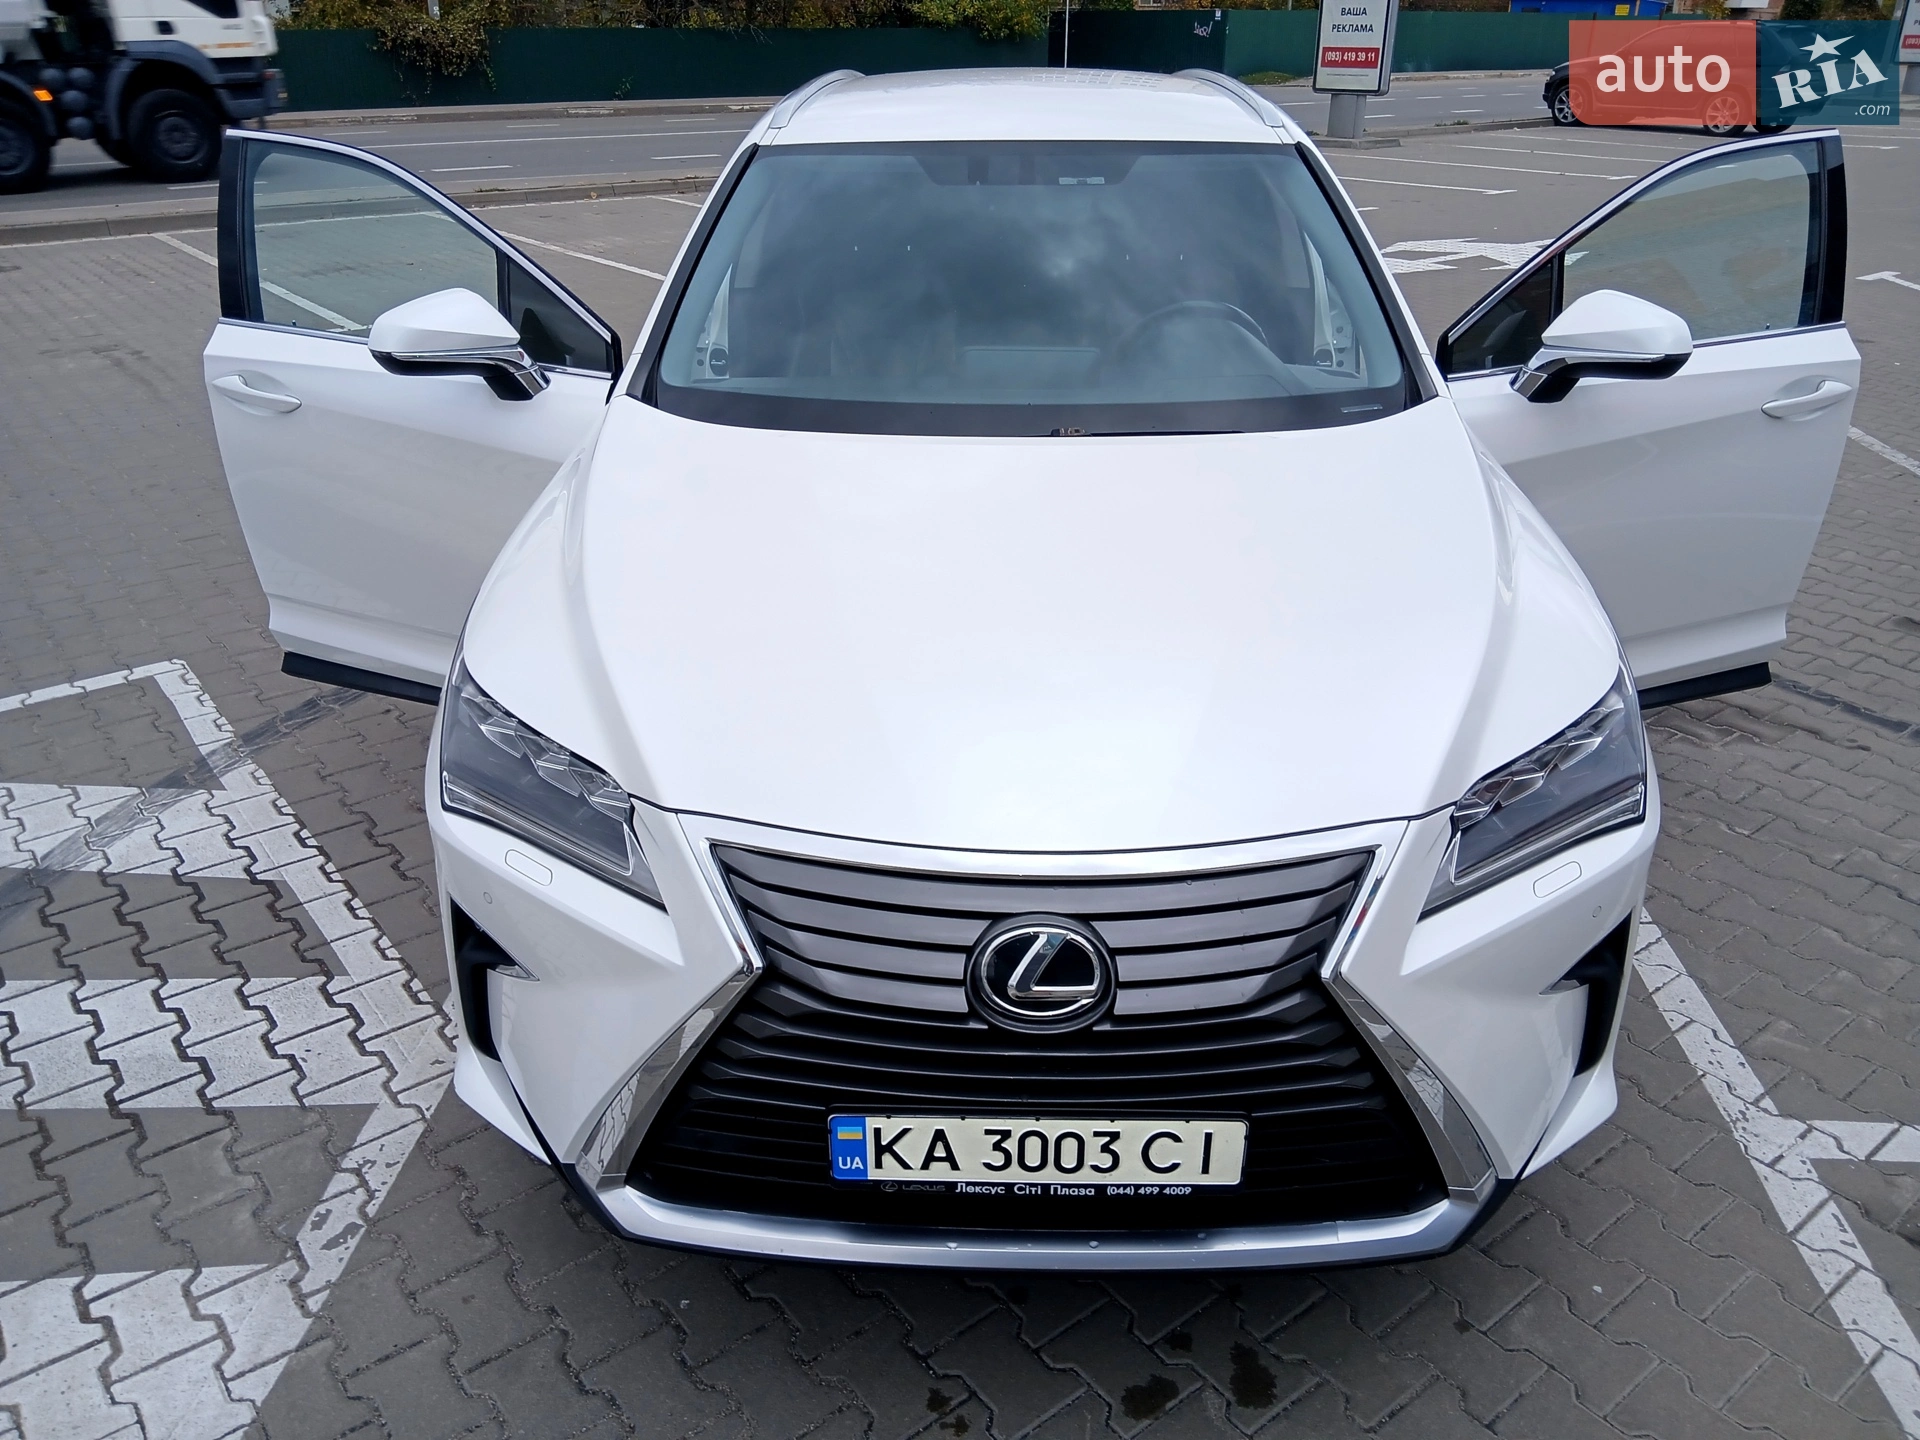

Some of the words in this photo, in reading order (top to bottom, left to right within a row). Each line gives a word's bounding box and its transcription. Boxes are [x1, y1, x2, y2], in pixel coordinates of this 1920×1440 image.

[1341, 7, 1367, 16] ВАША
[1332, 24, 1374, 33] РЕКЛАМА
[1325, 51, 1342, 63] (093)
[1343, 52, 1356, 61] 419
[1357, 52, 1366, 61] 39
[1367, 52, 1375, 61] 11
[838, 1156, 864, 1170] UA
[872, 1127, 961, 1171] KA
[981, 1129, 1121, 1174] 3003
[902, 1183, 946, 1192] LEXUS
[955, 1182, 1006, 1195] Лексус
[1014, 1183, 1041, 1195] Сіті
[1050, 1184, 1095, 1196] Плаза
[1107, 1185, 1135, 1196] (044)
[1137, 1186, 1160, 1195] 499
[1162, 1186, 1192, 1195] 4009
